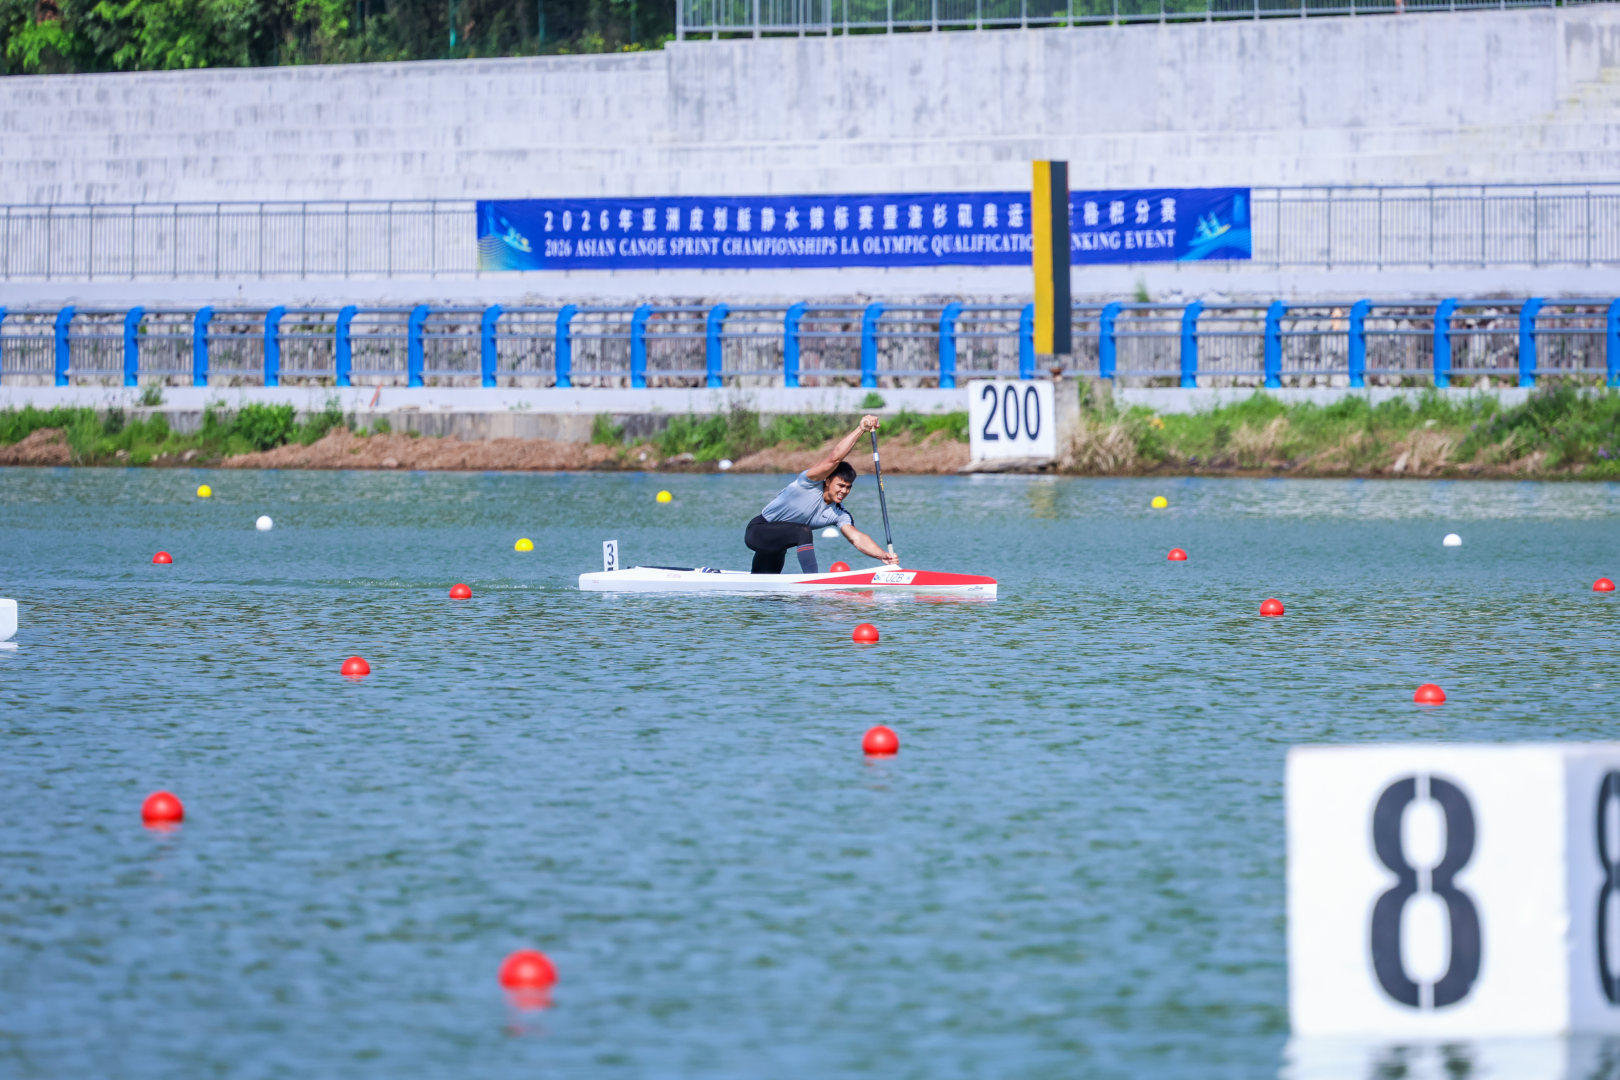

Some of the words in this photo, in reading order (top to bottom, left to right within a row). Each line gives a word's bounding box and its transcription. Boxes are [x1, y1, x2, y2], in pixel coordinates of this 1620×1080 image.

[545, 238, 572, 257] 2026
[575, 238, 616, 257] ASIAN
[619, 237, 667, 256] CANOE
[670, 236, 720, 256] SPRINT
[722, 235, 838, 256] CHAMPIONSHIPS
[841, 235, 860, 255] LA
[863, 234, 929, 254] OLYMPIC
[931, 233, 1034, 257] QUALIFICATIO
[1070, 231, 1121, 252] NKING
[1124, 229, 1177, 250] EVENT
[982, 384, 1040, 441] 200
[606, 543, 615, 566] 3
[885, 573, 905, 583] UZB
[1370, 774, 1483, 1010] 8
